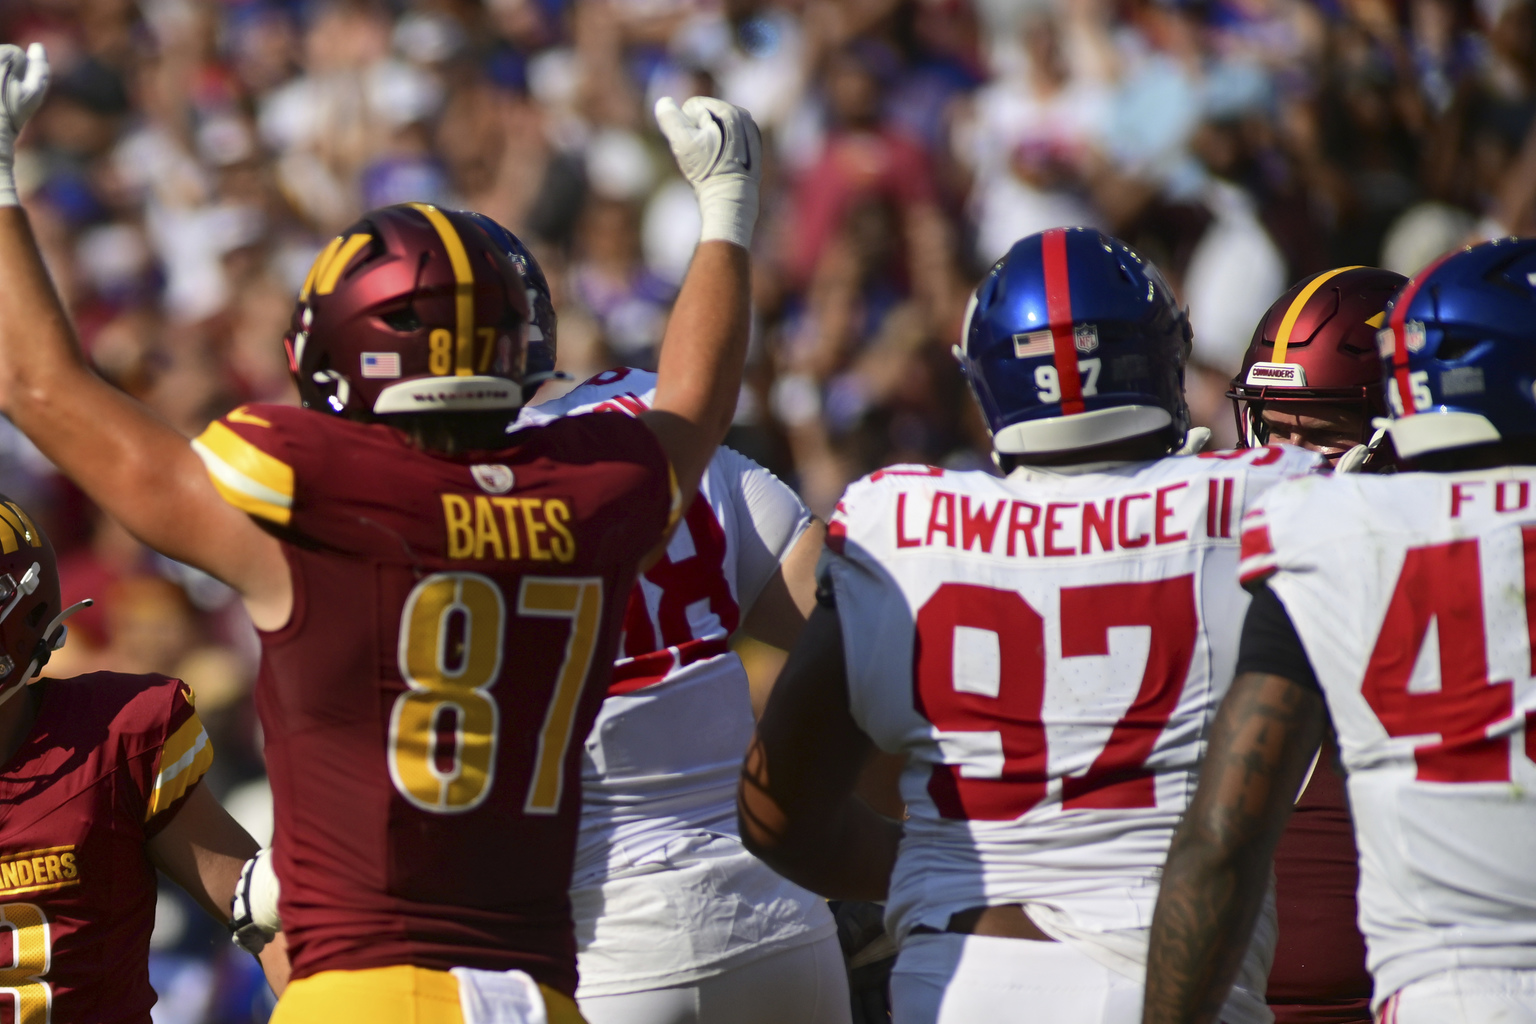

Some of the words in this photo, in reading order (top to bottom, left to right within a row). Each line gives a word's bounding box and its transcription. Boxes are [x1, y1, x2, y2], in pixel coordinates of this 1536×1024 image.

[1079, 336, 1096, 348] NFL
[442, 493, 576, 564] BATES
[896, 481, 1190, 558] LAWRENCE
[1206, 478, 1235, 538] II
[387, 571, 604, 816] 87
[913, 571, 1200, 821] 97
